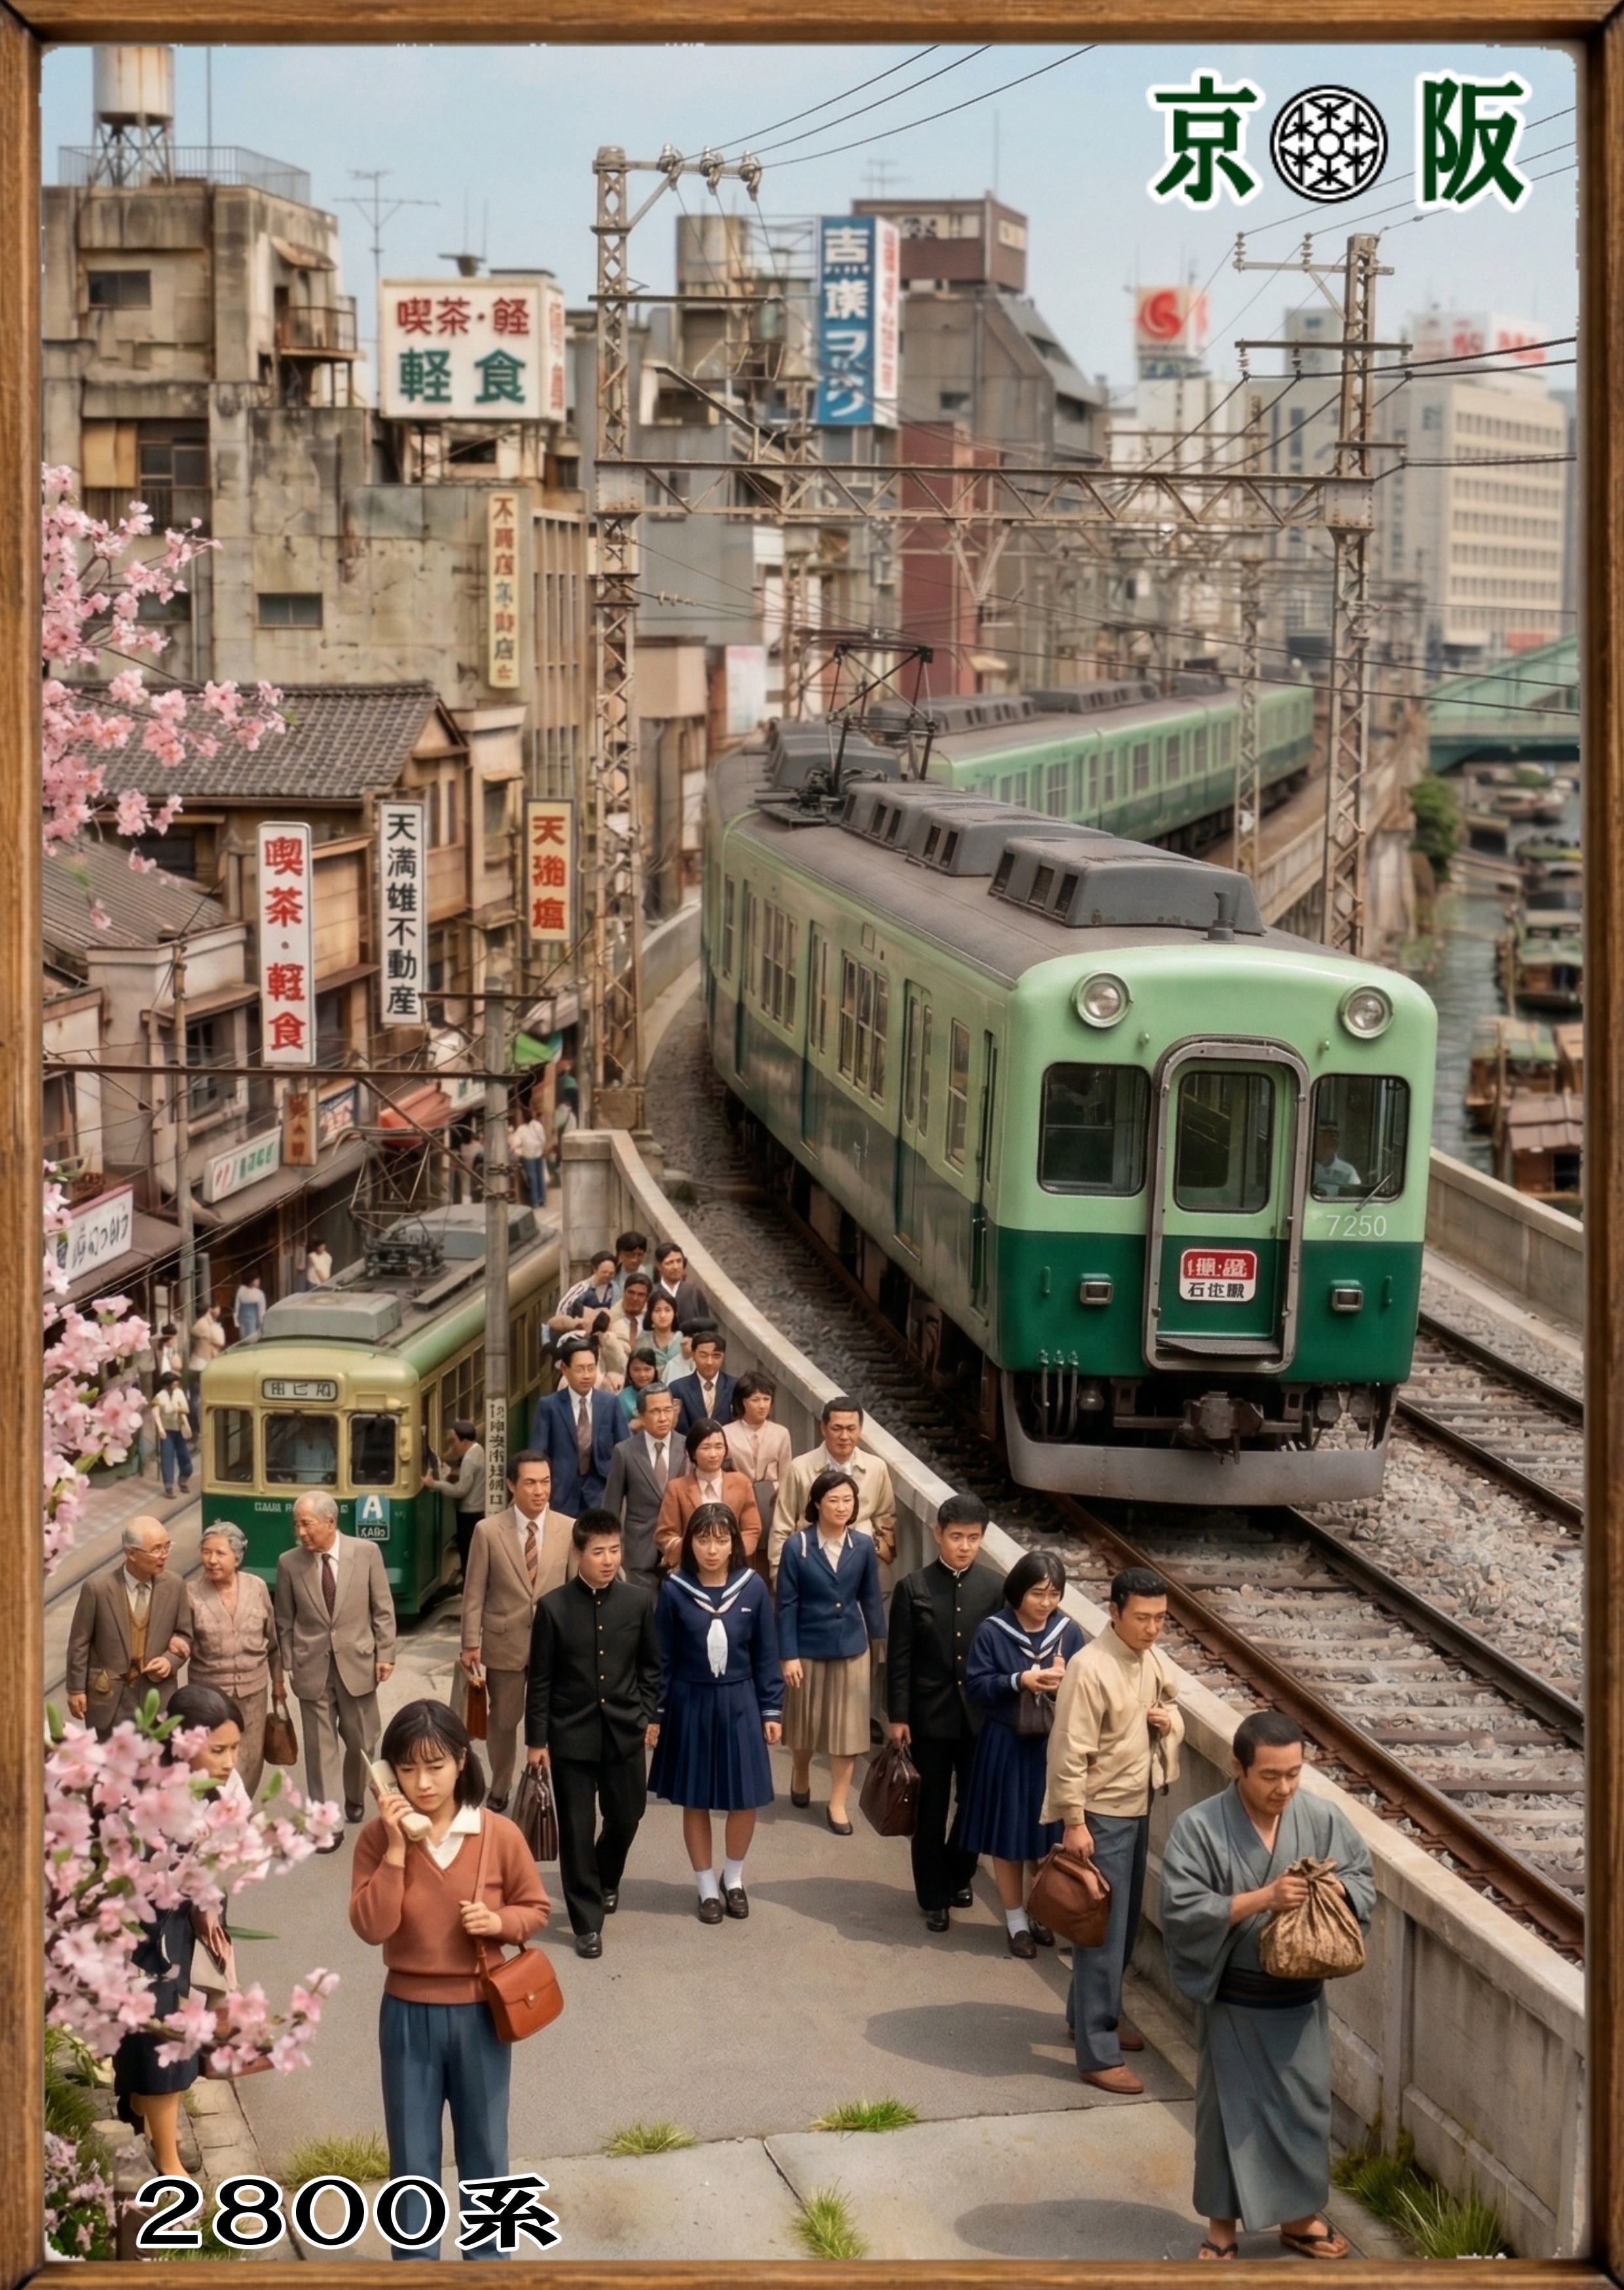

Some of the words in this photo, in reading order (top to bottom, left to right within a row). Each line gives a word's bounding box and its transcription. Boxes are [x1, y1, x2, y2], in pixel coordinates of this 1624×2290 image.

[398, 347, 526, 404] 軽食
[264, 836, 306, 1051] 喫茶・軽食
[1325, 1214, 1387, 1237] 7250
[362, 1495, 383, 1519] A
